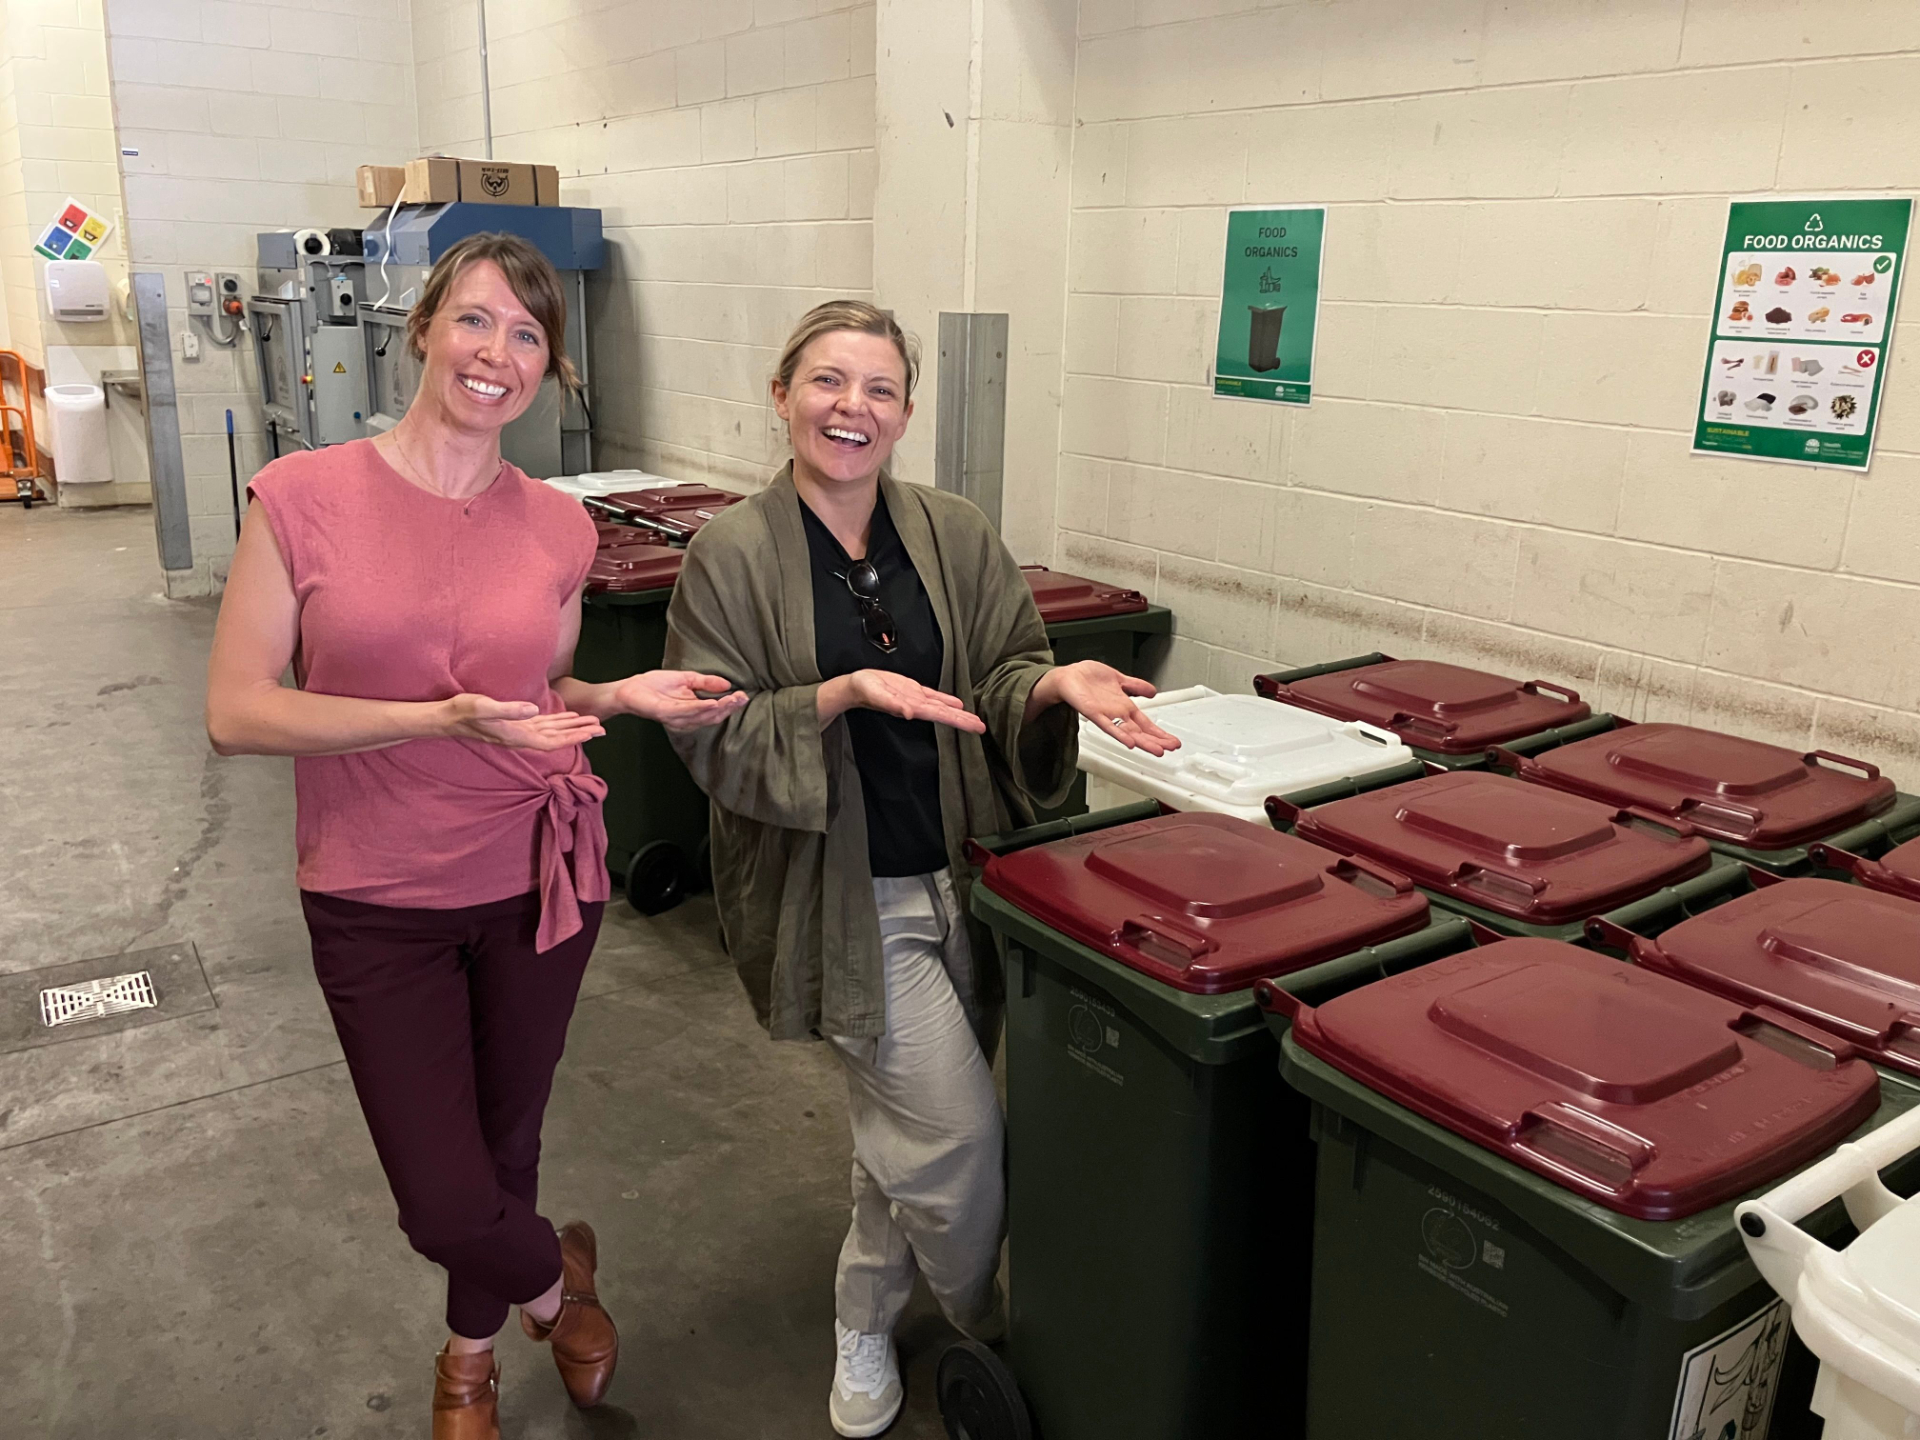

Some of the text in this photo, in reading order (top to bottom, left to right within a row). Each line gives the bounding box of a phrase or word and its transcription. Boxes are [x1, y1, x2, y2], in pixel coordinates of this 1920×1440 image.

[1258, 227, 1287, 239] FOOD
[1743, 235, 1883, 249] FOOD ORGANICS
[1244, 246, 1298, 258] ORGANICS
